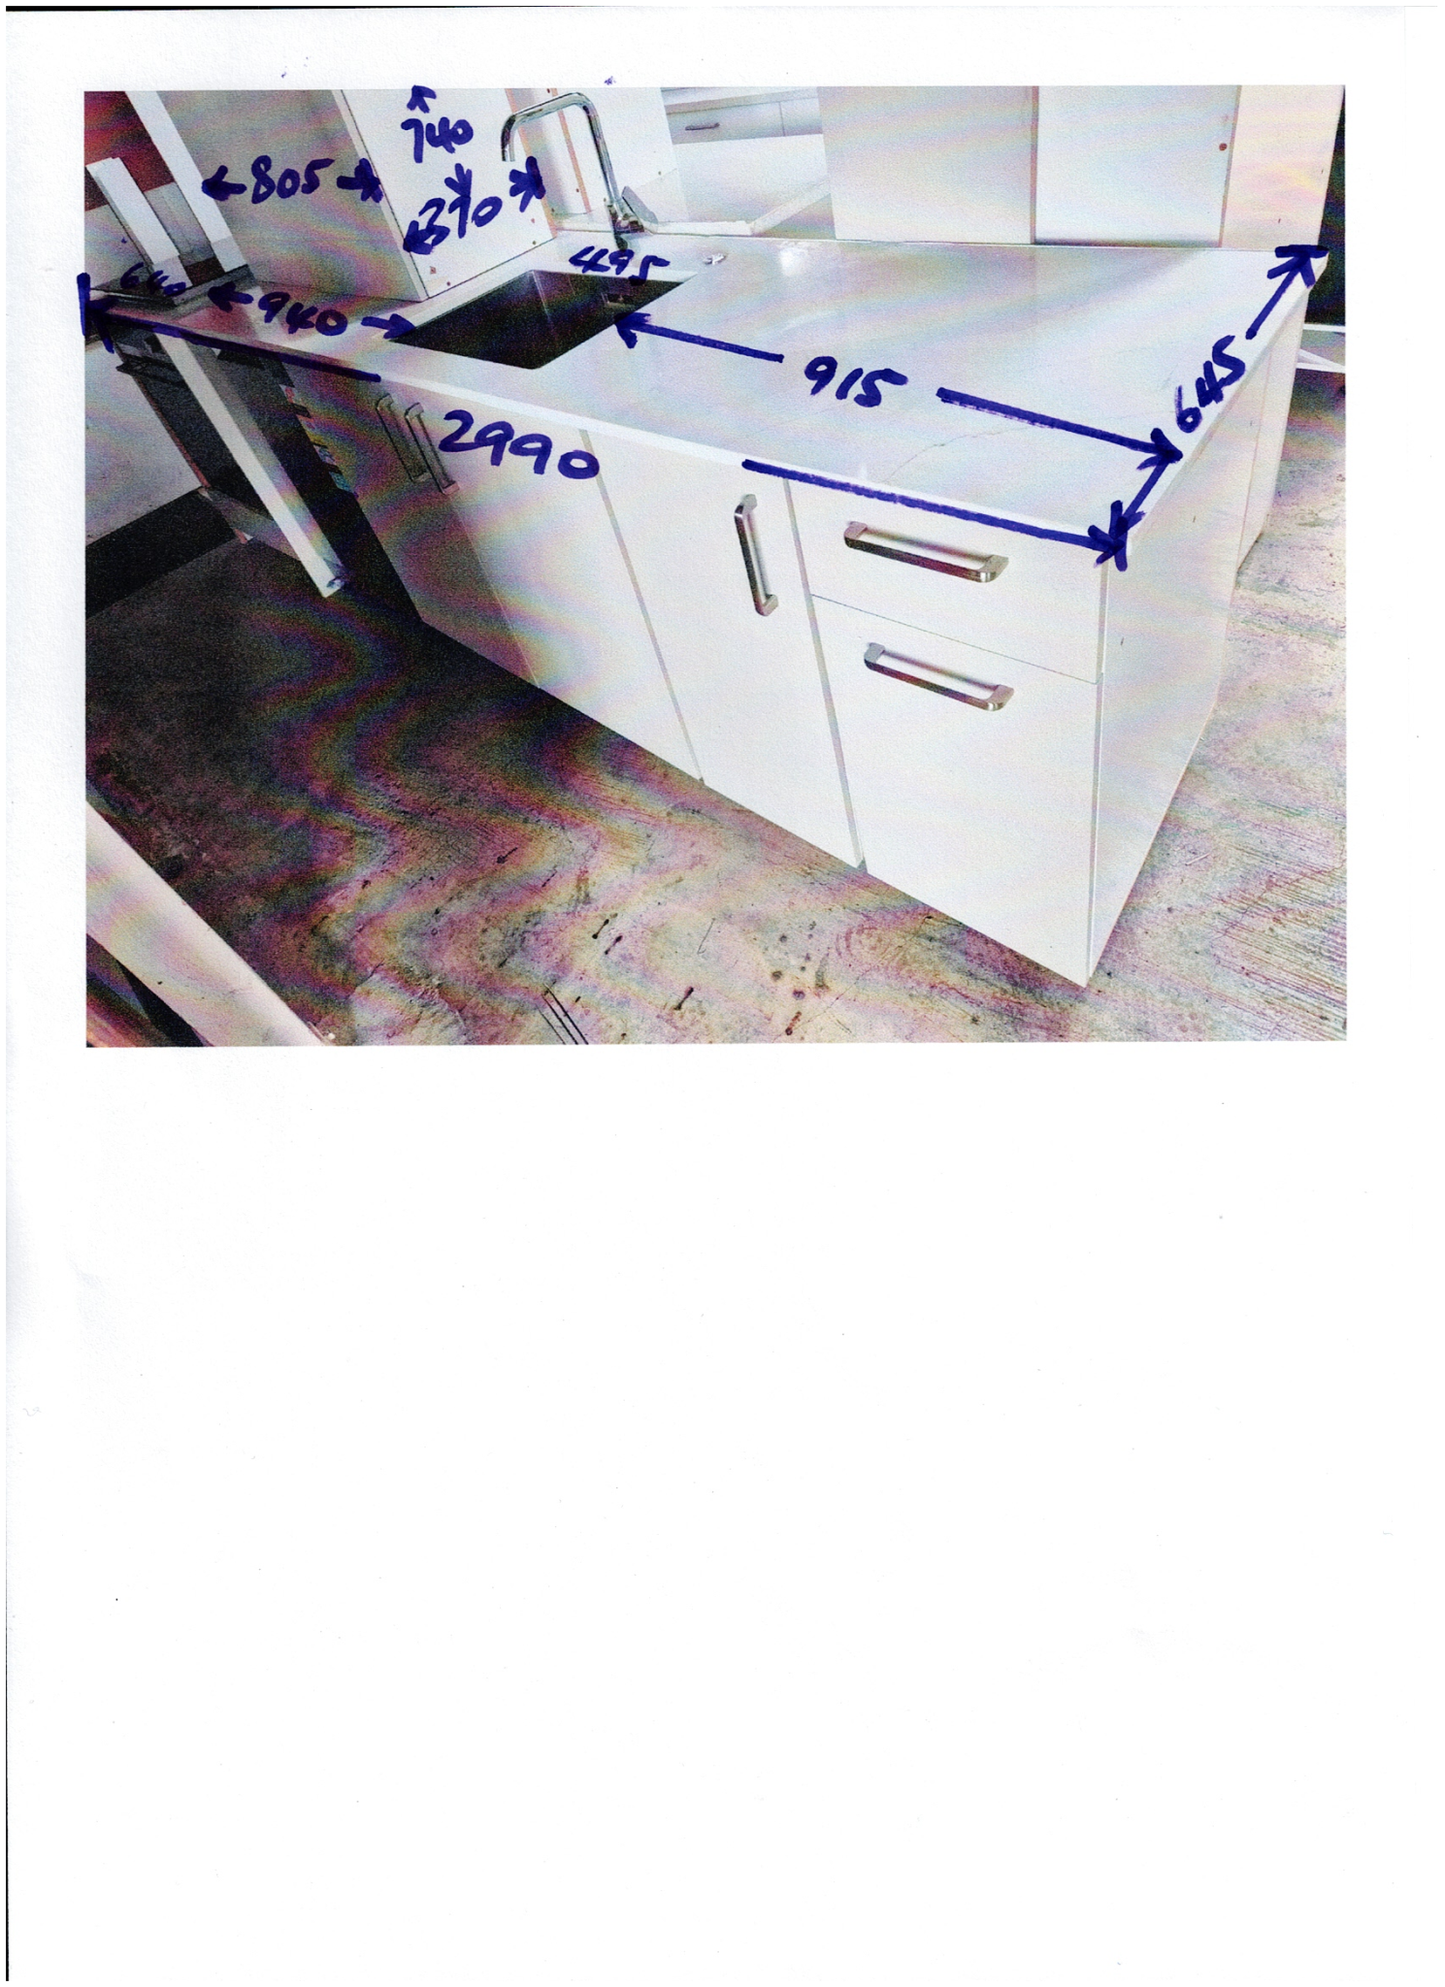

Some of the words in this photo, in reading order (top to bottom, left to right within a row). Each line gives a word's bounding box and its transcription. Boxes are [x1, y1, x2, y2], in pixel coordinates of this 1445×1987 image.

[401, 117, 474, 163] 740
[251, 155, 335, 204] 805
[410, 195, 503, 247] 370
[568, 245, 670, 286] 495
[258, 291, 348, 336] 940
[804, 356, 909, 408] 915
[1174, 335, 1246, 433] 645
[438, 409, 600, 480] 2990
